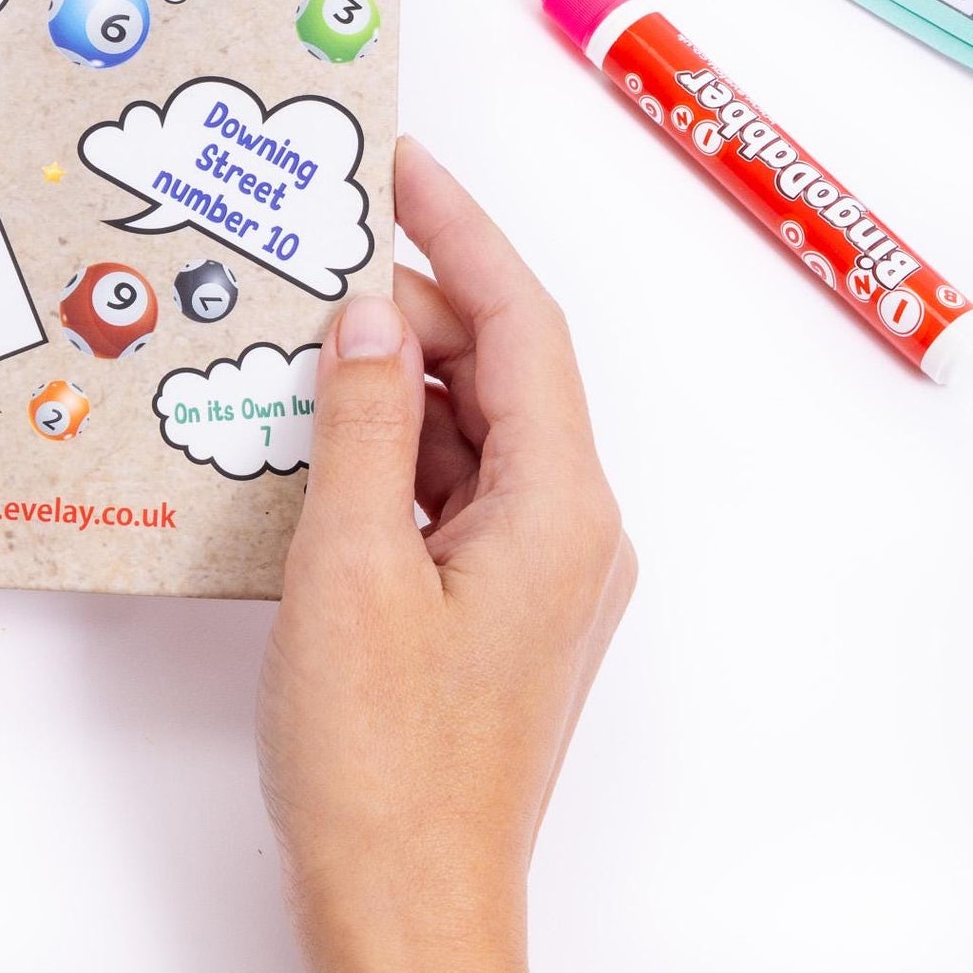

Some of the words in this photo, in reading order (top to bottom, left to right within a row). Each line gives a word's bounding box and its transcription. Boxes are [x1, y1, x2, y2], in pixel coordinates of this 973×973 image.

[100, 13, 131, 44] 6
[203, 101, 319, 191] Downing
[195, 143, 287, 211] Street
[675, 68, 921, 291] BingoDabber
[152, 170, 259, 239] number
[262, 226, 299, 261] 10
[105, 281, 138, 311] 9
[41, 408, 63, 432] 2
[174, 402, 201, 425] On
[204, 397, 238, 424] its
[241, 397, 287, 420] Own
[260, 425, 272, 447] 7
